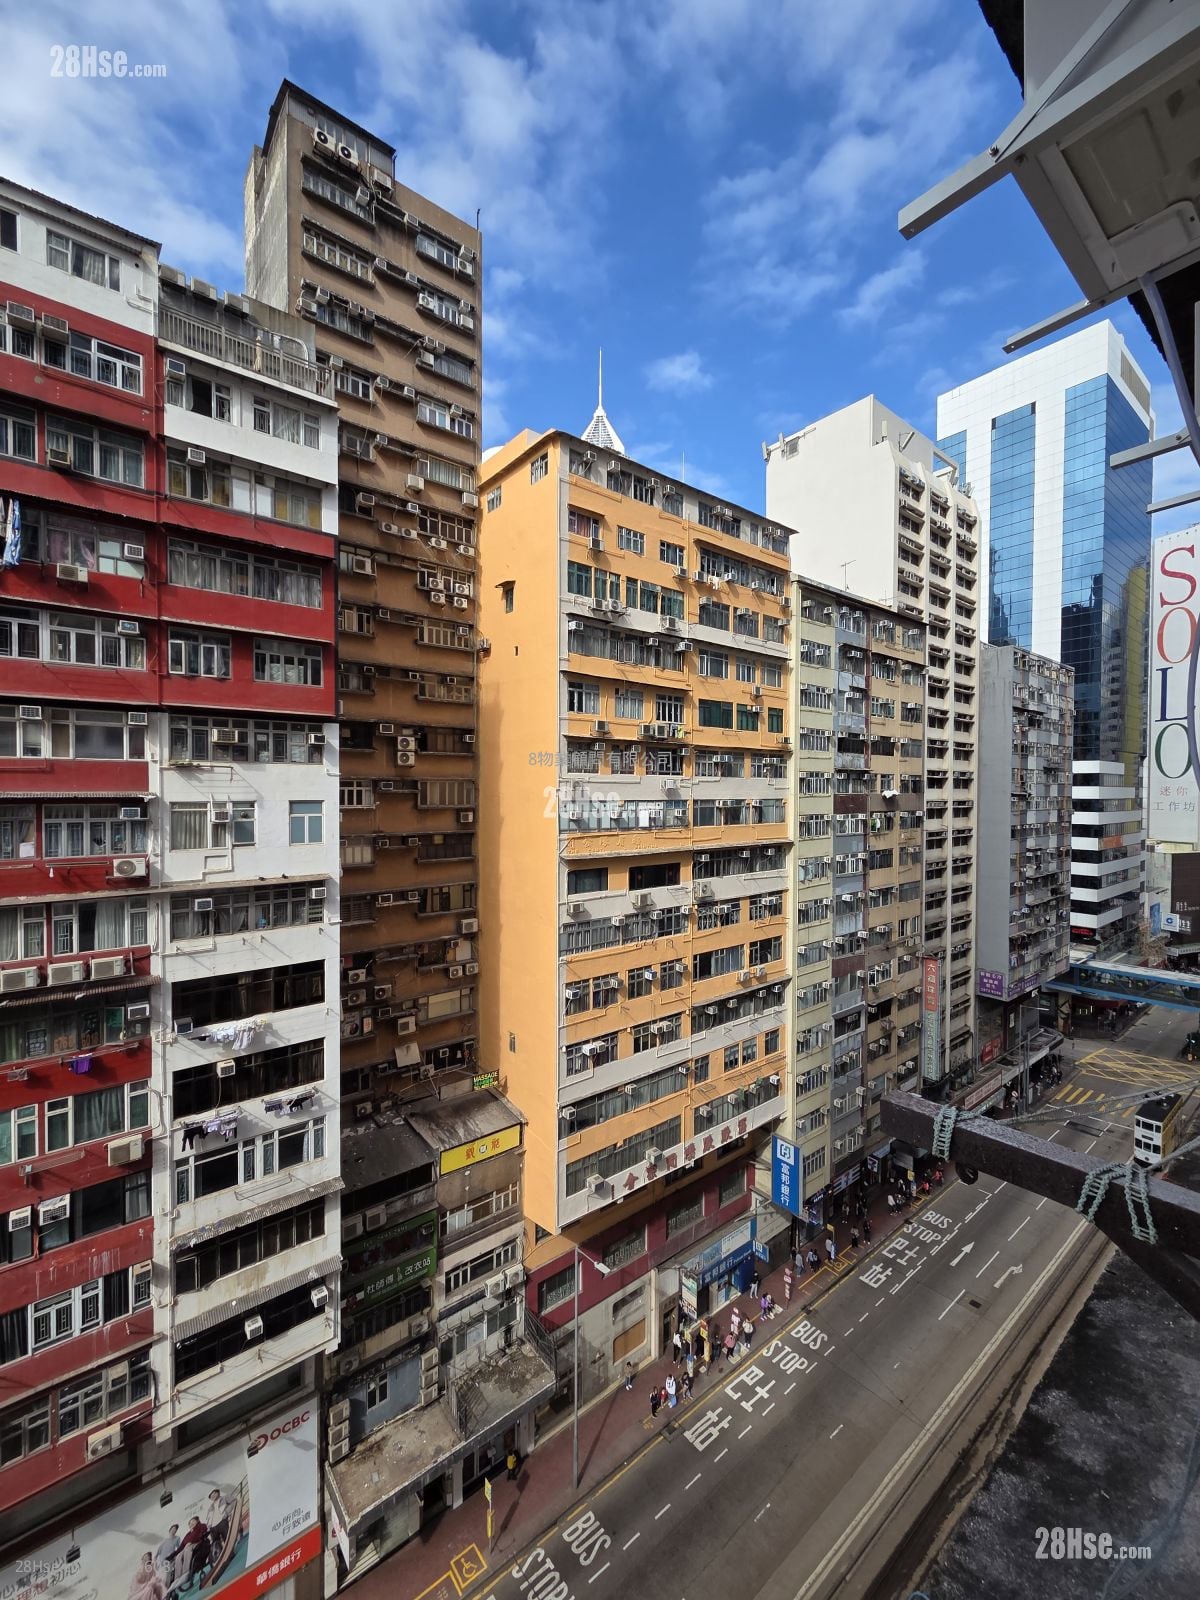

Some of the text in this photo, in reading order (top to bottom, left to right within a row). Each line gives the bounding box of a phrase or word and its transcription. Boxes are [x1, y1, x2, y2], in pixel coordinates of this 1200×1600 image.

[1155, 544, 1197, 779] SOLO
[1159, 784, 1188, 797] 迷你
[1154, 800, 1196, 812] 工作坊
[780, 1162, 790, 1206] 富邦銀行
[903, 1223, 942, 1244] STOP
[922, 1210, 952, 1229] BUS
[881, 1237, 920, 1266] 巴士
[859, 1263, 892, 1289] 站
[790, 1320, 828, 1350] BUS
[762, 1340, 808, 1375] STOP
[724, 1365, 776, 1413] 巴士
[270, 1411, 311, 1441] OCBC
[683, 1407, 732, 1451] 站
[562, 1511, 612, 1566] BUS
[511, 1547, 569, 1600] STOP
